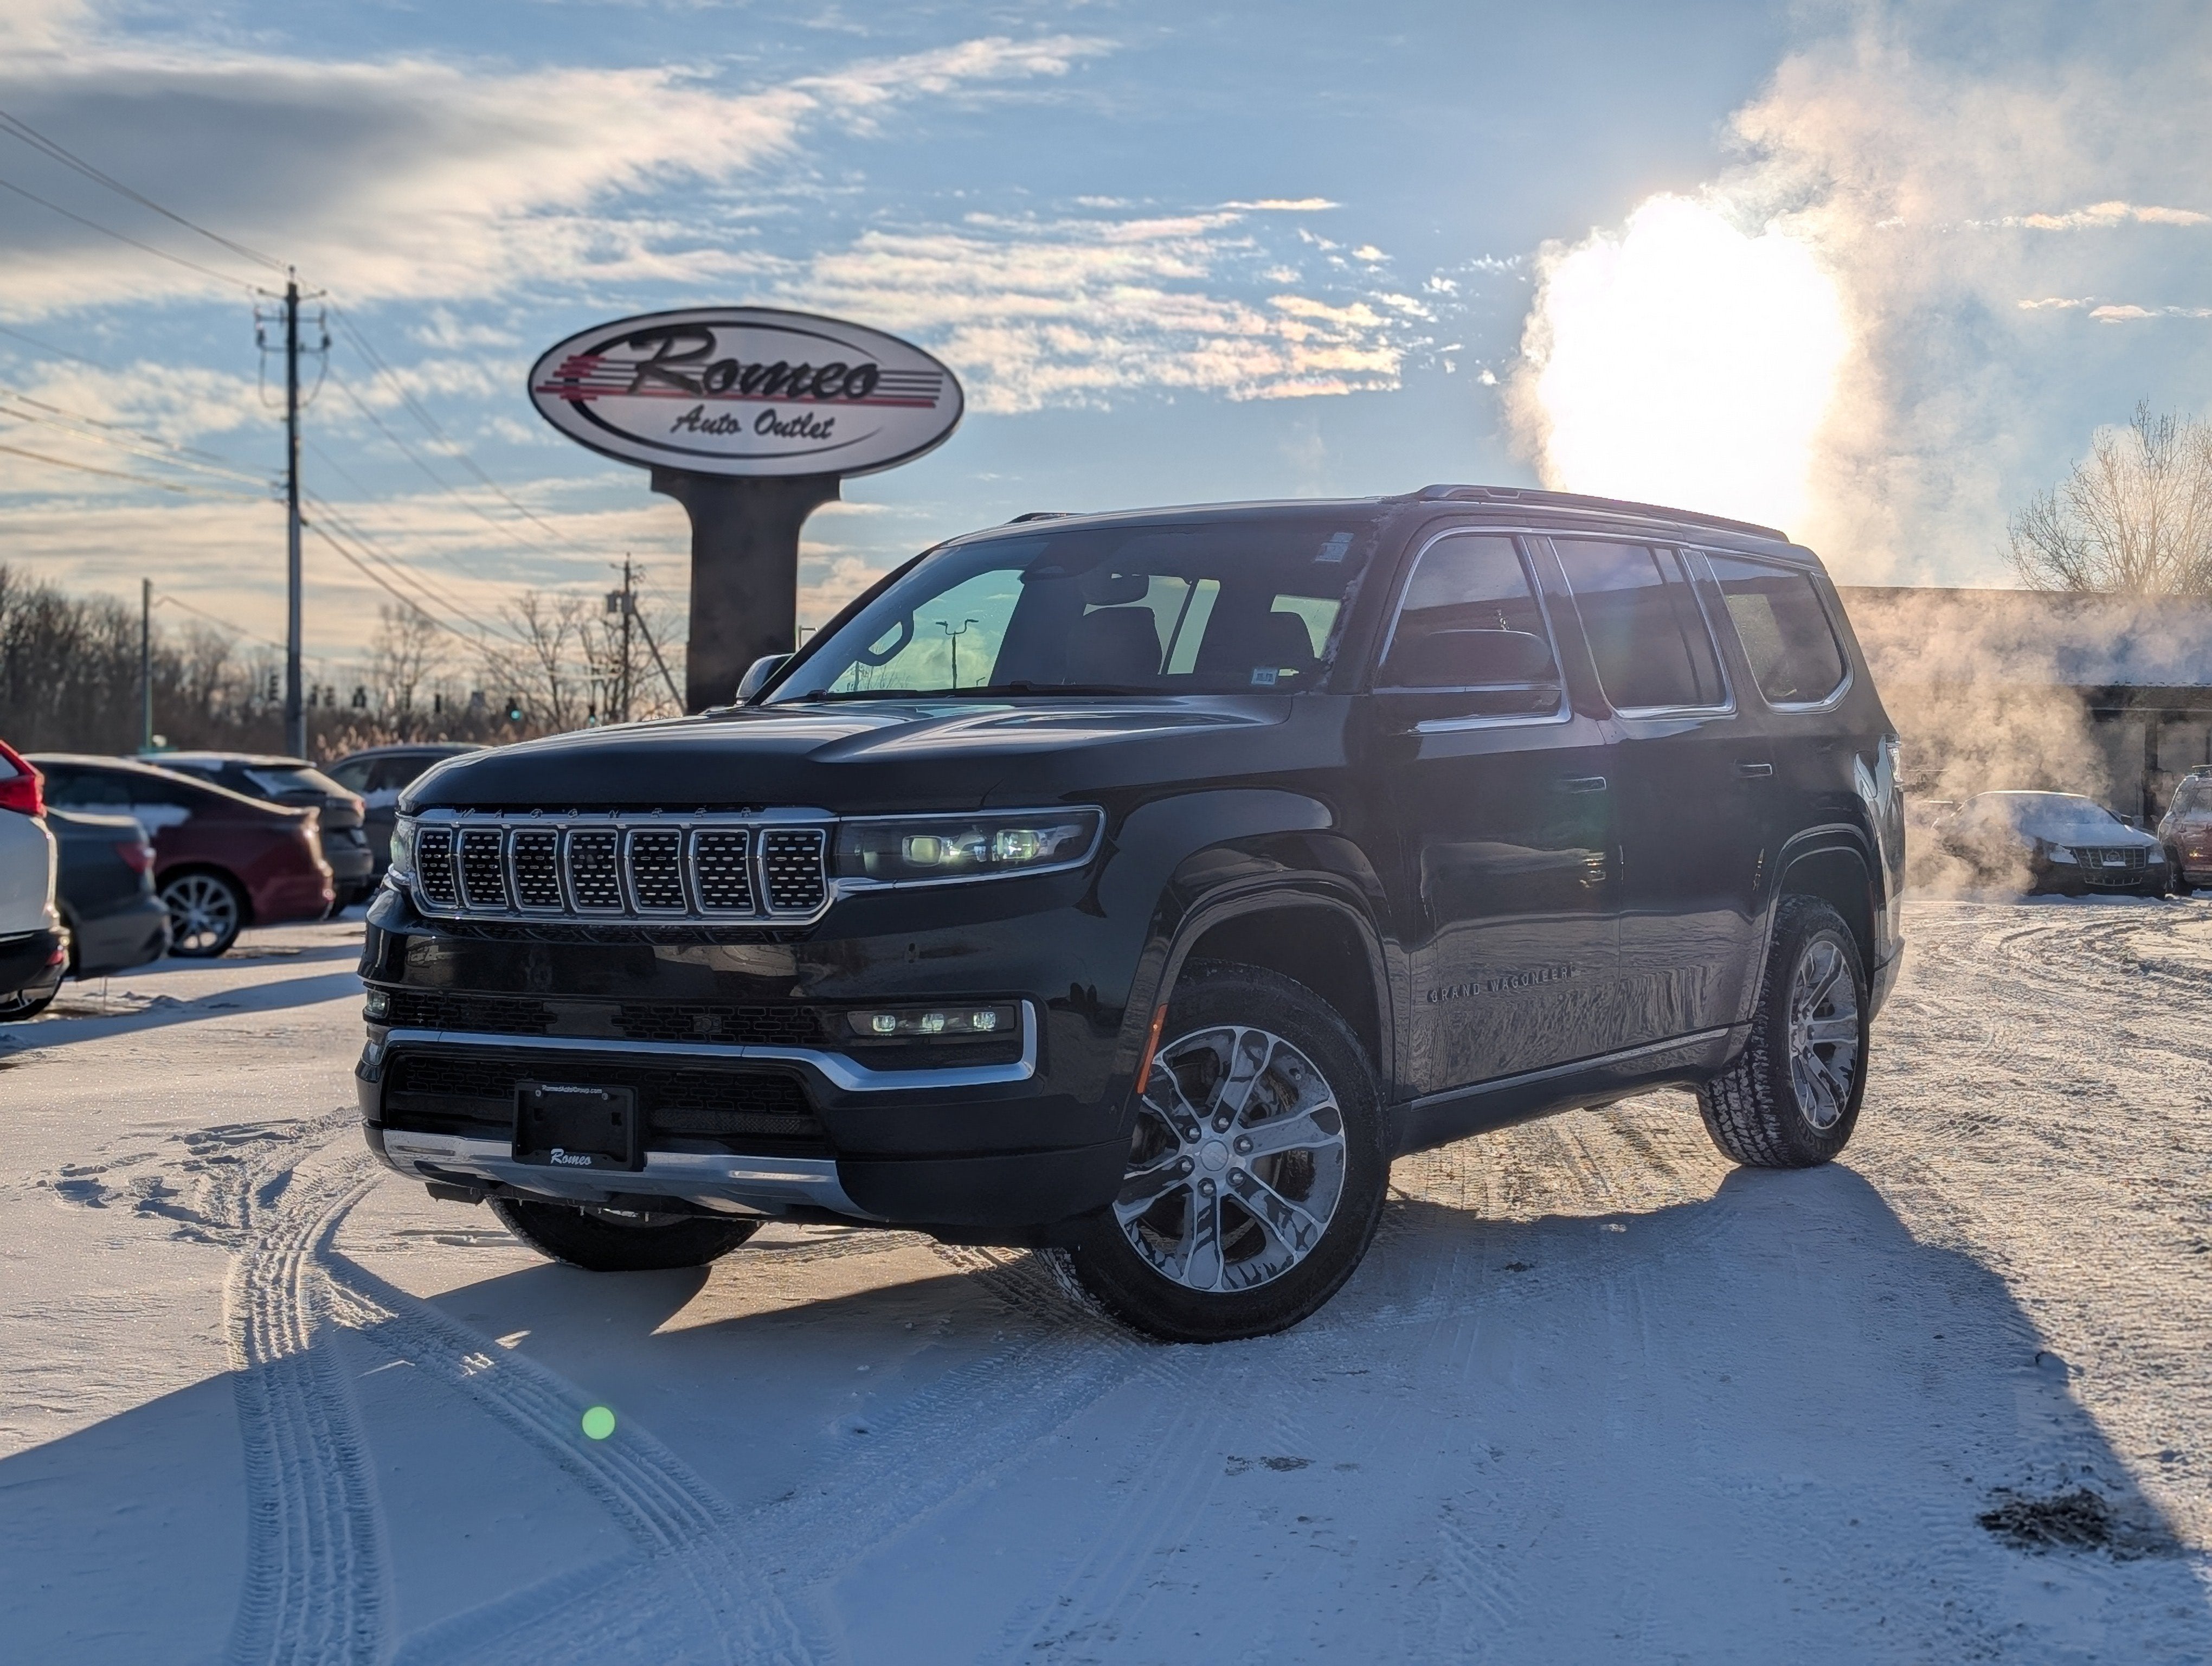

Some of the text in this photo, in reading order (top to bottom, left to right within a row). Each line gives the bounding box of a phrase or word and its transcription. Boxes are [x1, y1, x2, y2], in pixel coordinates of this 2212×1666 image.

[626, 325, 879, 400] Romeo
[670, 404, 835, 439] Auto Outlet
[1430, 966, 1567, 1002] GRAND WAGONEER
[550, 1149, 591, 1165] Romeo
